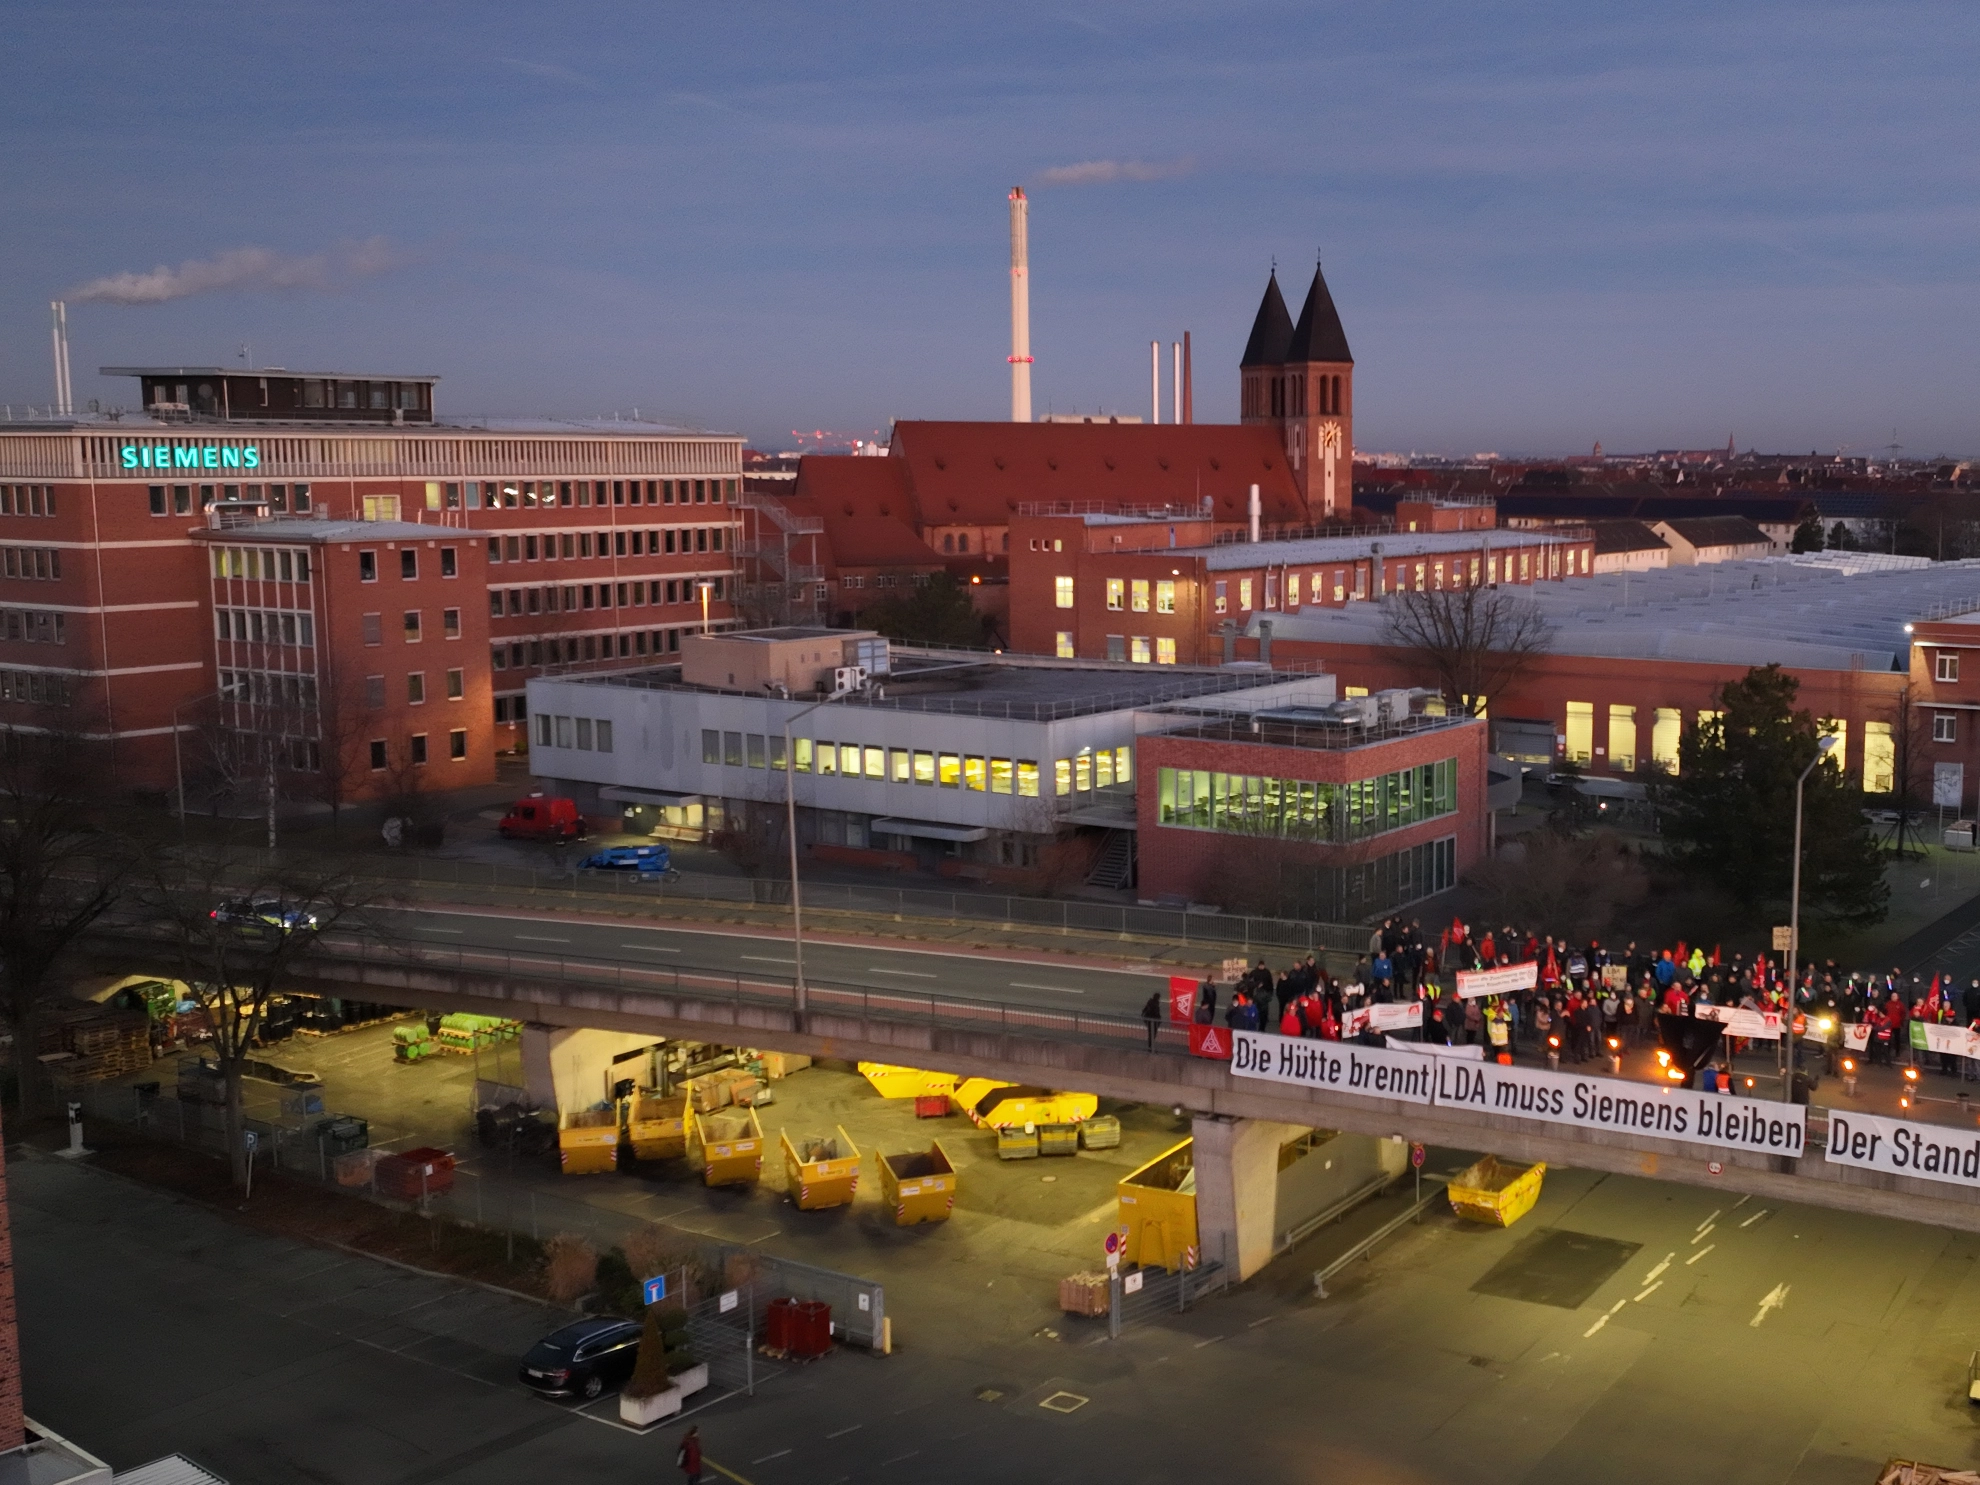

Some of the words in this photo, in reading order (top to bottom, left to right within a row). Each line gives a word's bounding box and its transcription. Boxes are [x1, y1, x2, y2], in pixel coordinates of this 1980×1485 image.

[121, 445, 259, 469] SIEMENS
[1235, 1037, 1271, 1073] Die
[1278, 1042, 1342, 1084] Hütte
[1349, 1052, 1430, 1097] brennt
[1439, 1063, 1486, 1105] LDA
[1495, 1080, 1564, 1115] muss
[1573, 1082, 1688, 1133] Siemens
[1697, 1099, 1801, 1150] bleiben
[246, 1133, 255, 1149] P
[1831, 1118, 1882, 1161] Der
